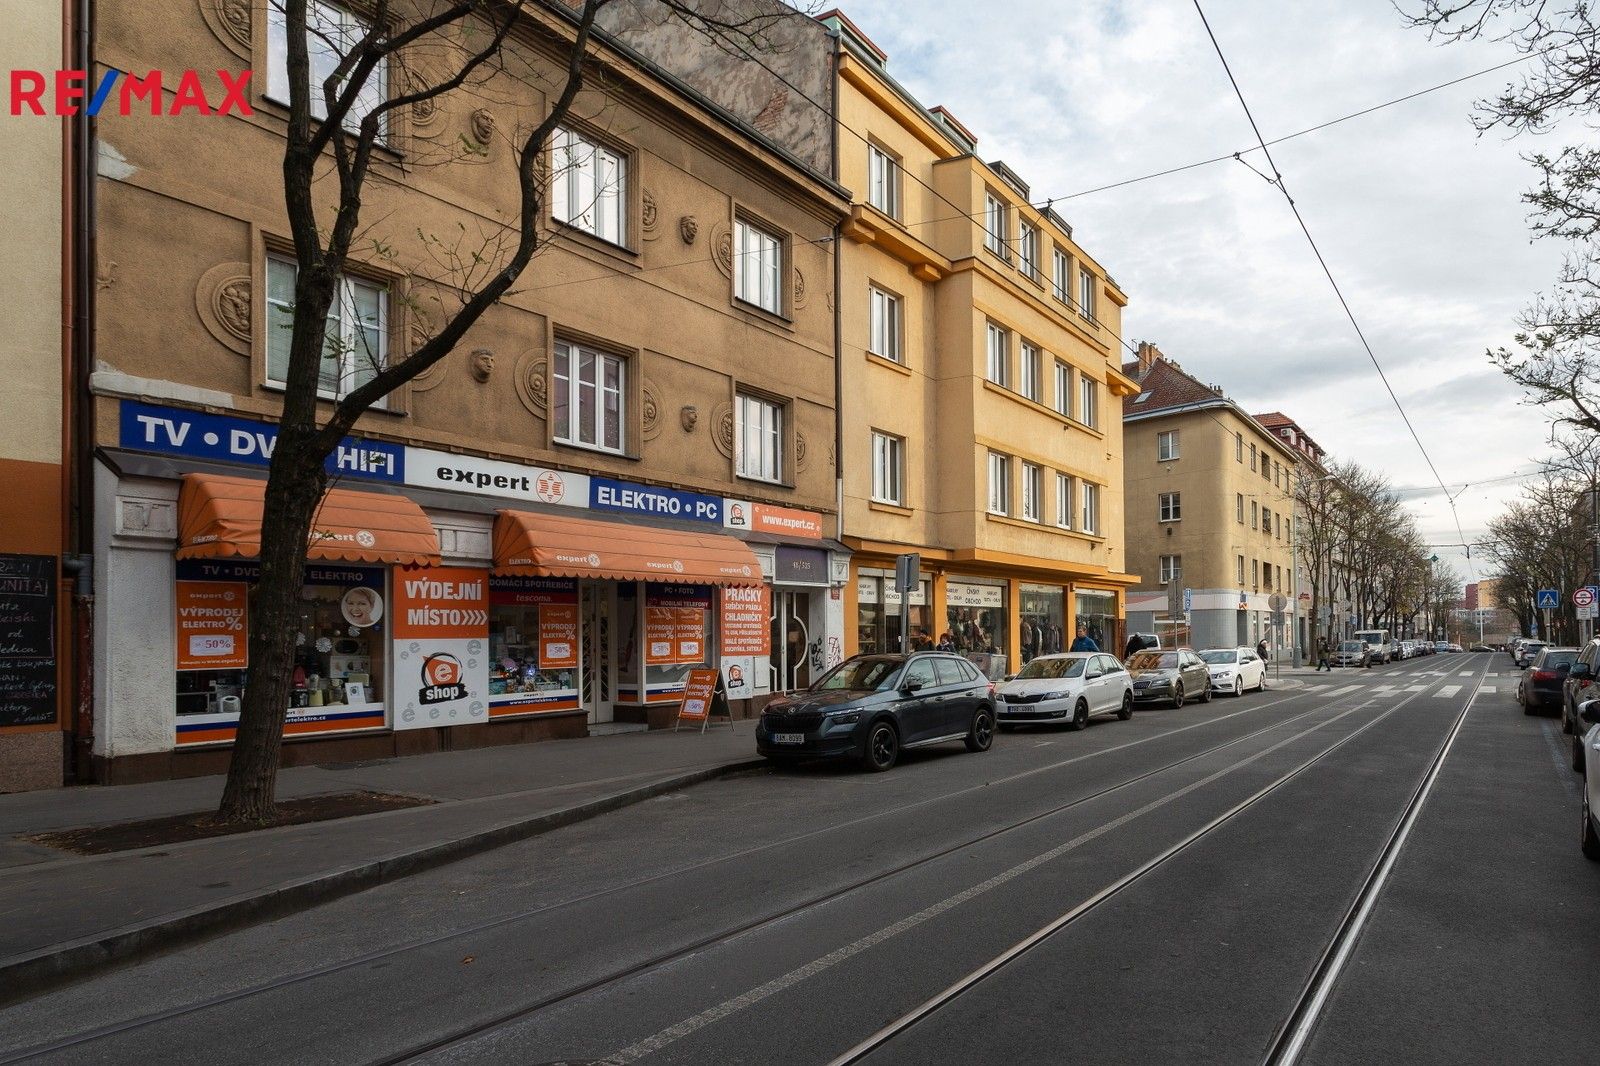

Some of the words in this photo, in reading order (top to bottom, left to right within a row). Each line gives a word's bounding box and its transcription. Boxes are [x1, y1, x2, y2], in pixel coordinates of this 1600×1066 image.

[137, 414, 191, 447] TV
[230, 429, 277, 459] DV
[337, 446, 394, 476] HIFI
[436, 466, 530, 492] expert
[597, 485, 681, 515] ELEKTRO
[696, 501, 718, 520] PC
[762, 514, 815, 531] www.expert.cz
[556, 553, 588, 565] expert
[646, 560, 672, 571] expert
[202, 565, 219, 576] TV
[310, 570, 364, 582] ELEKTRO
[719, 566, 742, 575] expert
[405, 576, 482, 601] VÝDEJNÍ
[725, 586, 762, 602] PRAČKY
[180, 606, 244, 617] VÝPRODEJ
[407, 604, 461, 626] MÍSTO
[182, 620, 226, 629] ELEKTRO
[425, 685, 459, 701] shop
